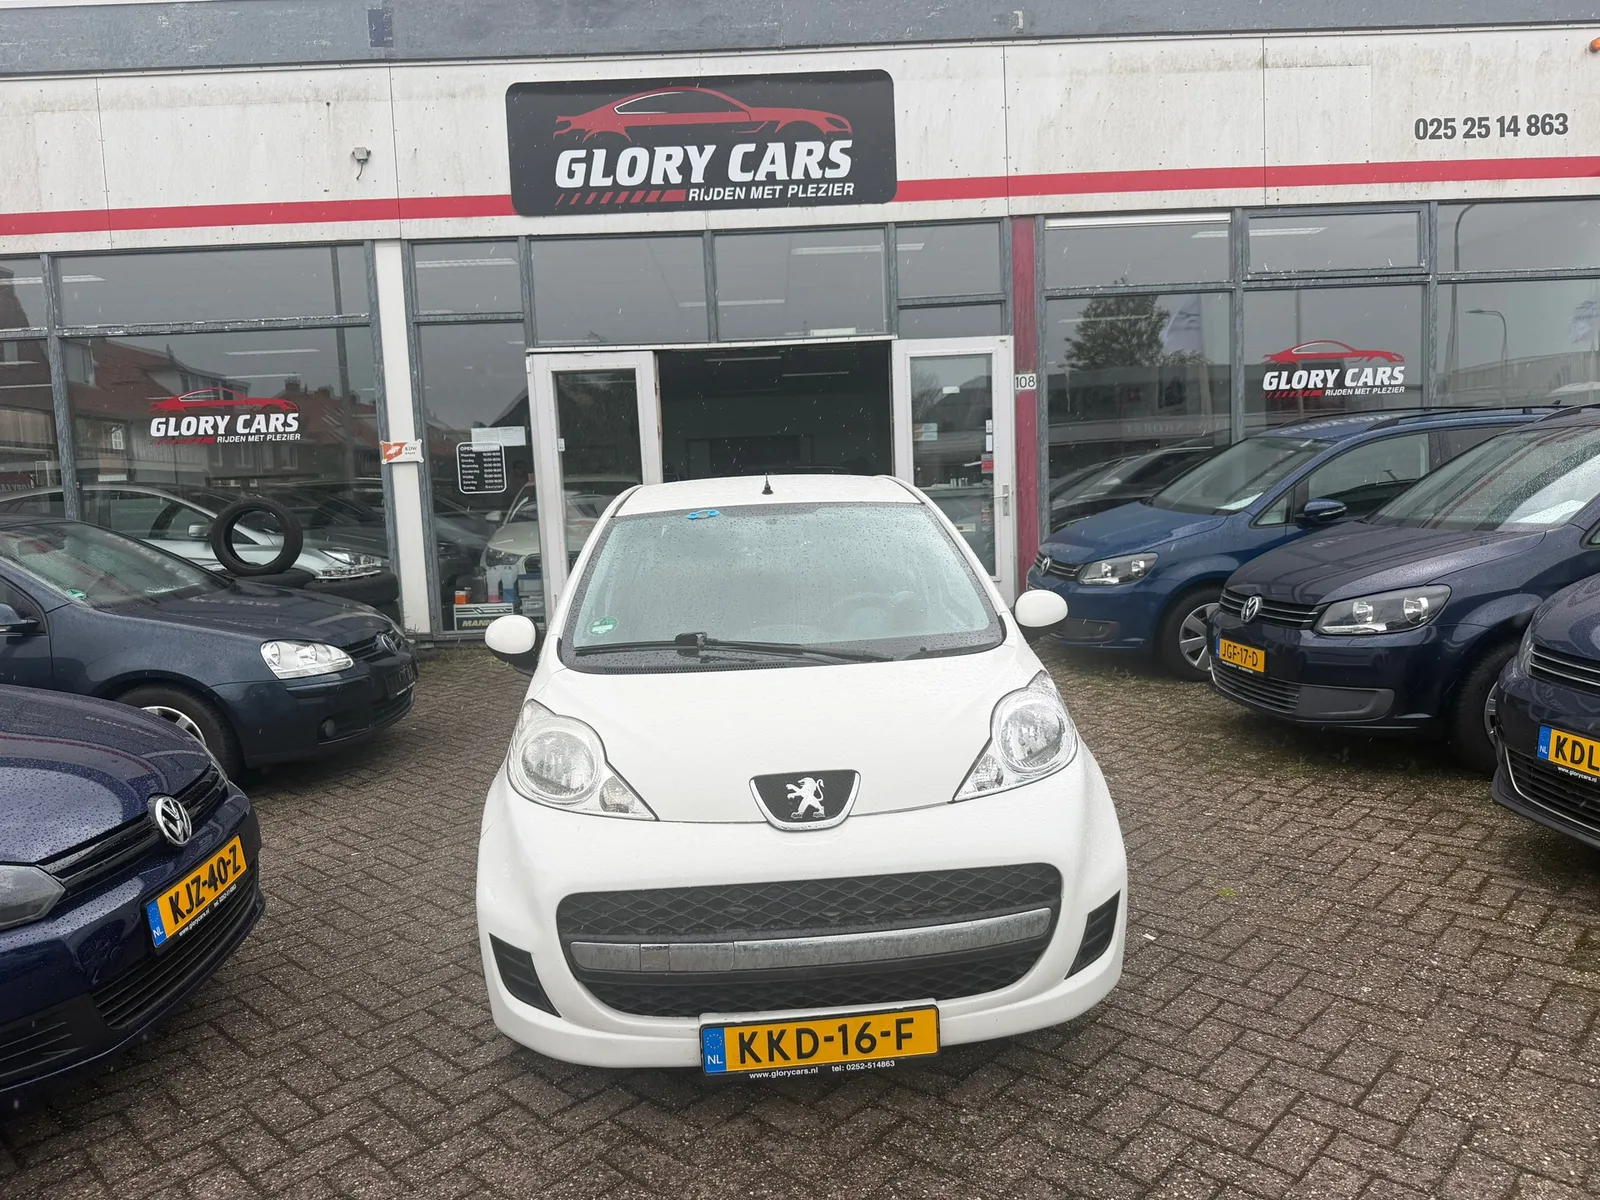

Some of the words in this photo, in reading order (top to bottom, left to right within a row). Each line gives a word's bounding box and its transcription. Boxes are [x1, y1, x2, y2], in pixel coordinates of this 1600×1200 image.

[1414, 117, 1456, 140] 025
[1463, 116, 1490, 139] 25
[1496, 115, 1521, 138] 14
[1526, 113, 1569, 136] 863
[554, 145, 716, 188] GLORY
[727, 139, 853, 183] CARS
[688, 186, 747, 202] RIJDEN
[750, 185, 783, 200] MET
[787, 183, 855, 198] PLEZIER
[1015, 375, 1036, 389] 108
[1263, 369, 1341, 391] GLORY
[1344, 366, 1406, 388] CARS
[1325, 389, 1353, 397] RIJDEN
[1372, 386, 1405, 395] PLEZIER
[150, 415, 231, 437] GLORY
[236, 413, 299, 434] CARS
[248, 434, 265, 442] MET
[267, 433, 301, 441] PLEZIER
[1222, 643, 1259, 667] JGF-17-D
[1540, 745, 1548, 754] NL
[168, 844, 241, 925] KJZ-40-Z
[153, 926, 164, 938] NL
[738, 1018, 914, 1064] KKD-16-F
[707, 1054, 723, 1065] NL
[749, 1066, 819, 1079] www.glorycars.nl
[831, 1064, 845, 1072] tel:
[846, 1060, 896, 1071] 0252-514863
